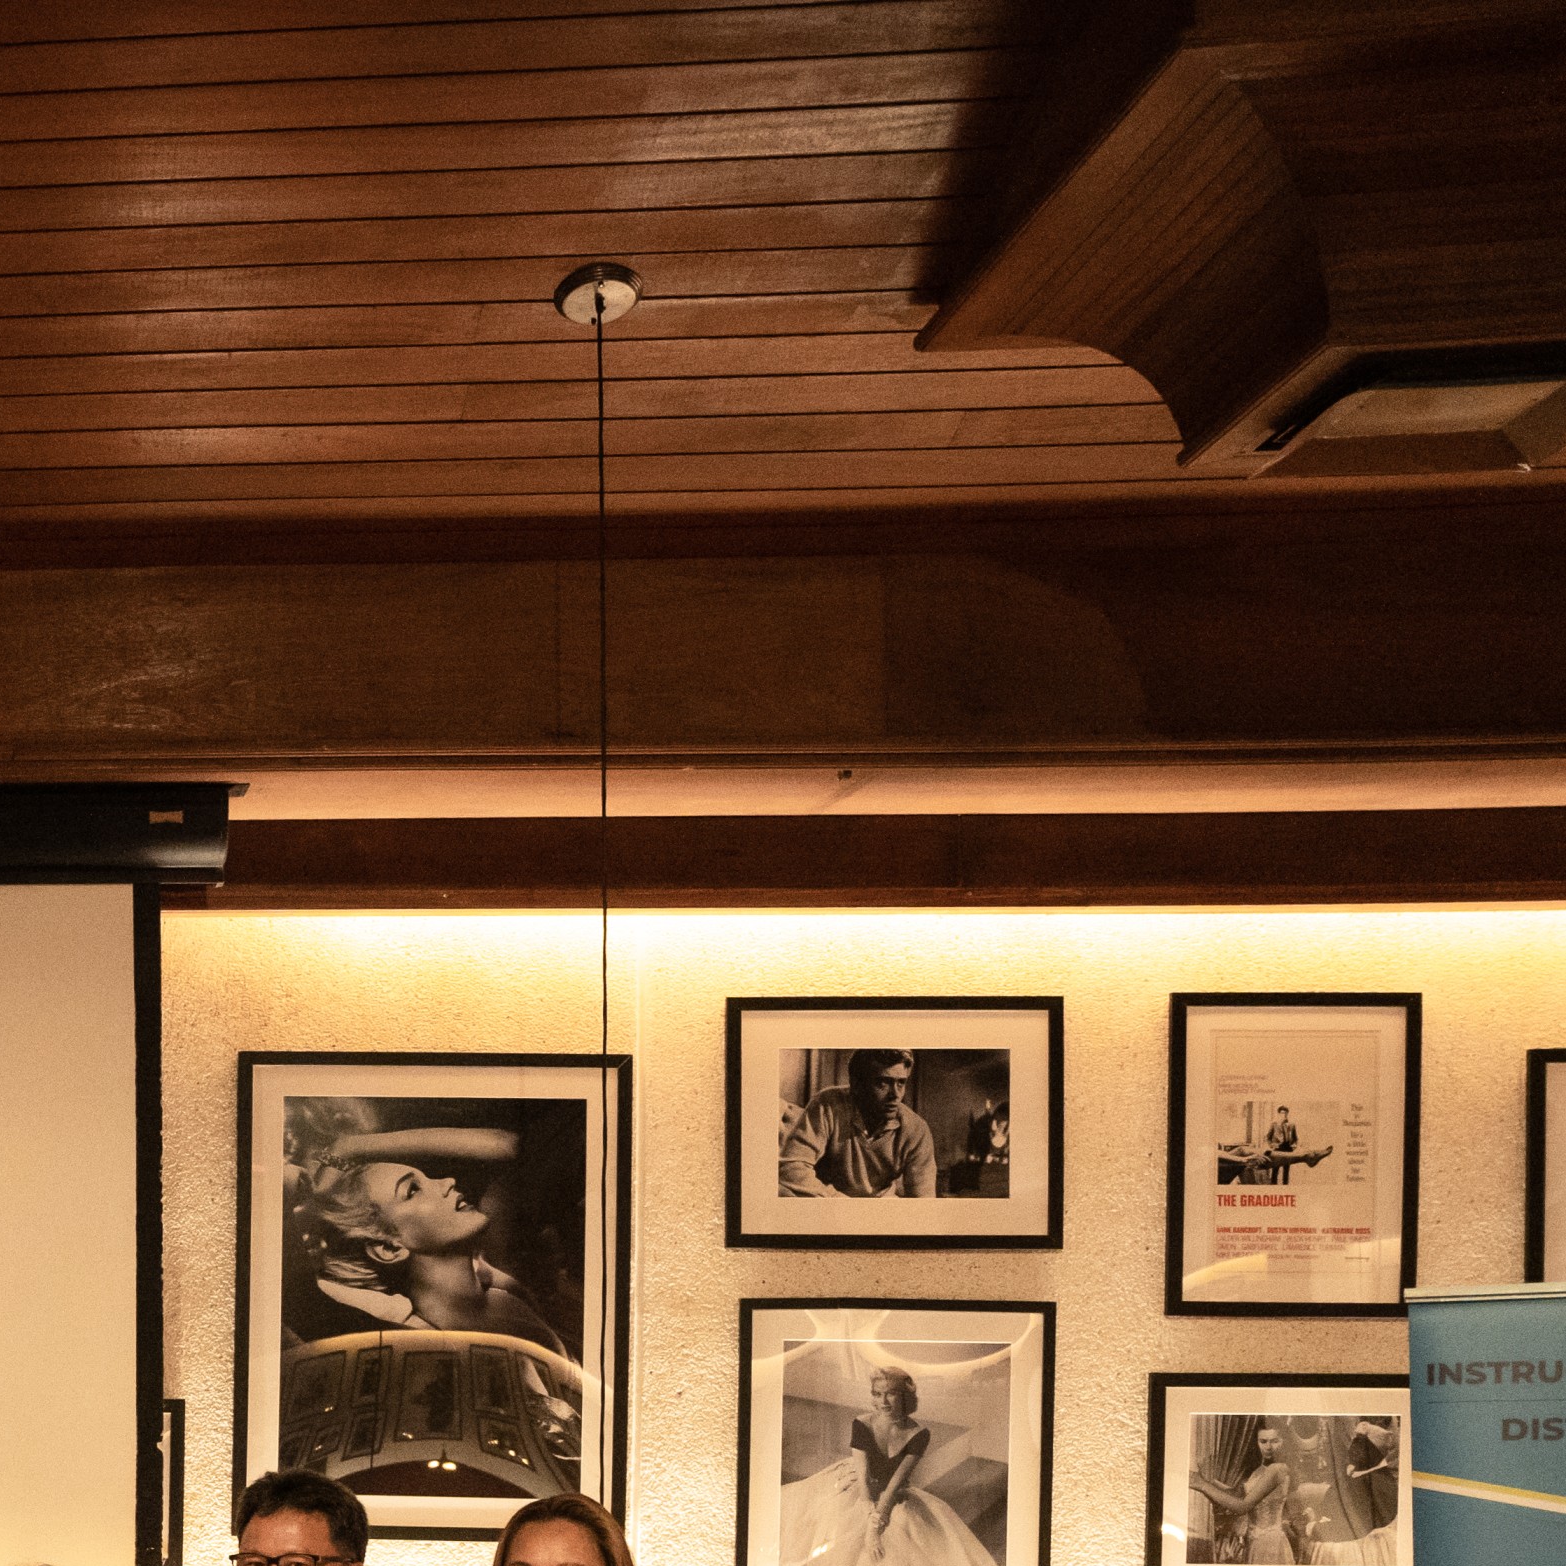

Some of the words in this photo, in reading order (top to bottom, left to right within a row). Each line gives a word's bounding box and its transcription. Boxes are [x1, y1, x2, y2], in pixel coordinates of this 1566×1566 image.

[1217, 1194, 1237, 1207] THE
[1240, 1194, 1297, 1208] GRADUATE
[1501, 1416, 1566, 1442] DIS
